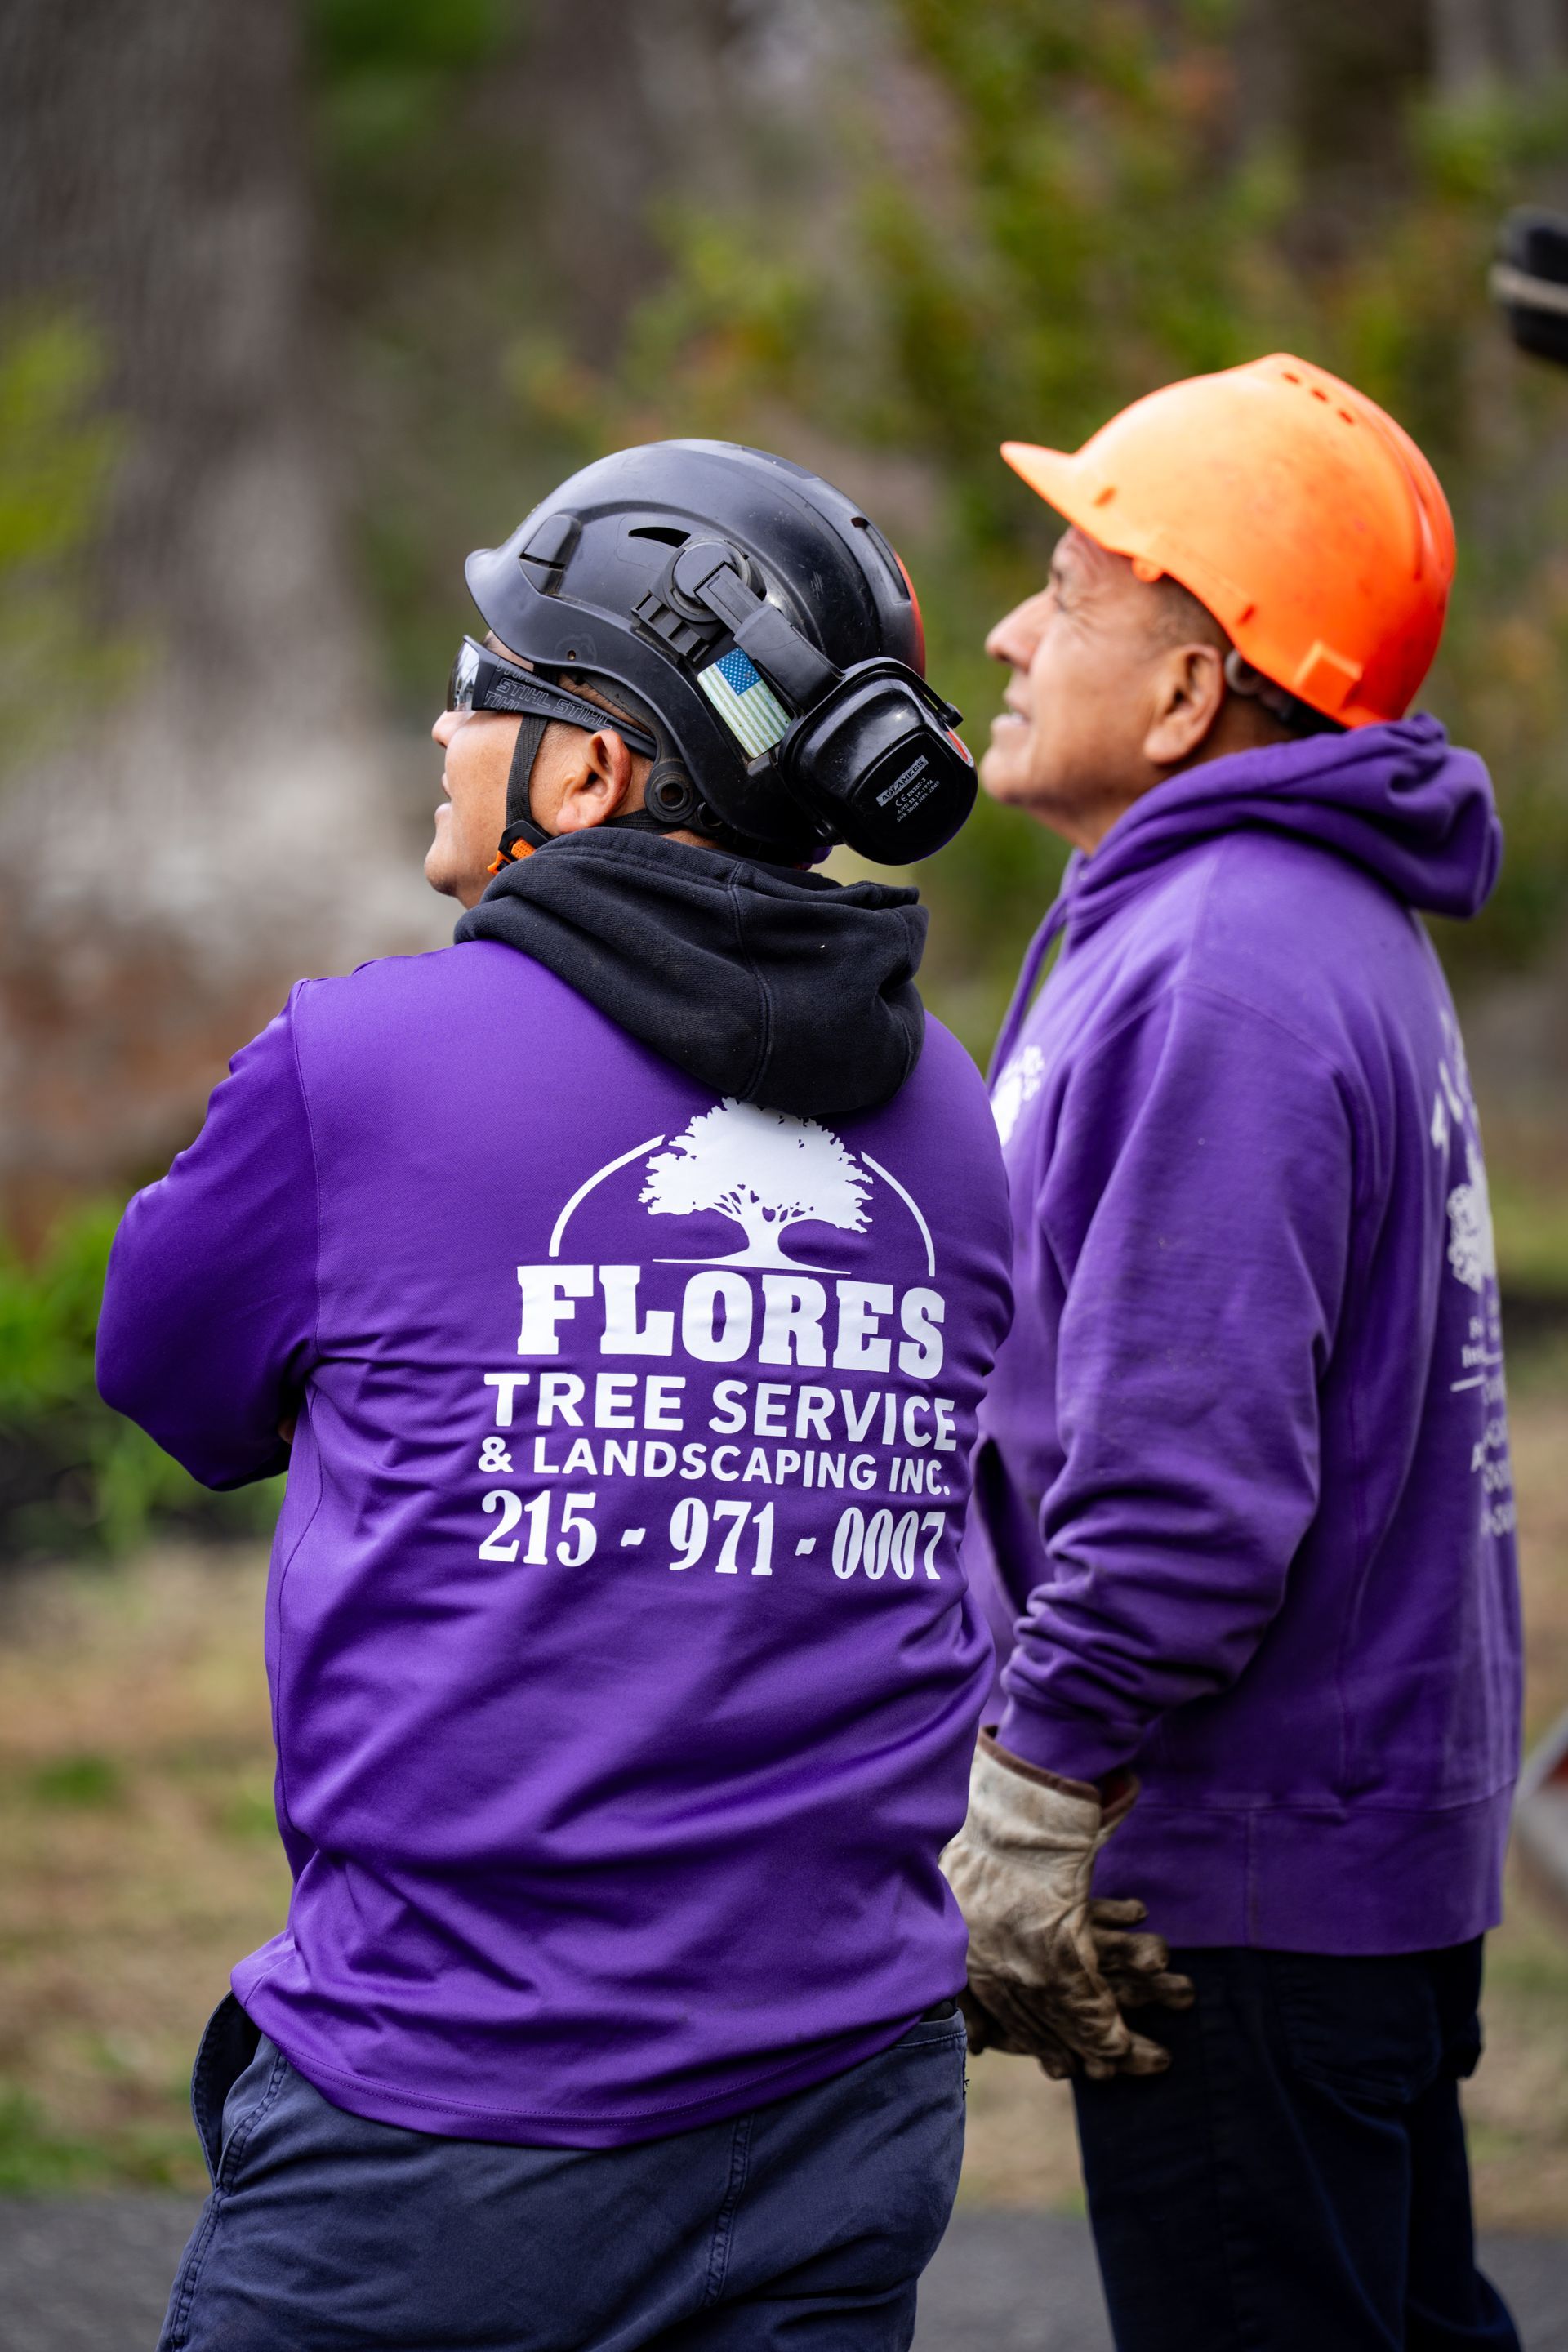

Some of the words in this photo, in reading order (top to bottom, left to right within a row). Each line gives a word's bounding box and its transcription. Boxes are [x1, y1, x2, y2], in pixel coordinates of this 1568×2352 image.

[496, 677, 551, 709] STIHL
[553, 698, 613, 730] STIHL
[896, 812, 907, 822] SNR
[907, 801, 920, 812] 30dB
[898, 804, 909, 814] ANSI
[906, 777, 926, 797] EN352-3
[517, 1265, 945, 1379] FLORES
[484, 1373, 686, 1434] TREE
[709, 1380, 957, 1450] SERVICE
[479, 1437, 514, 1472] &
[534, 1437, 878, 1490] LANDSCAPING
[889, 1458, 951, 1496] INC.
[479, 1490, 598, 1566] 215
[670, 1498, 773, 1576] 971
[832, 1507, 946, 1580] 0007
